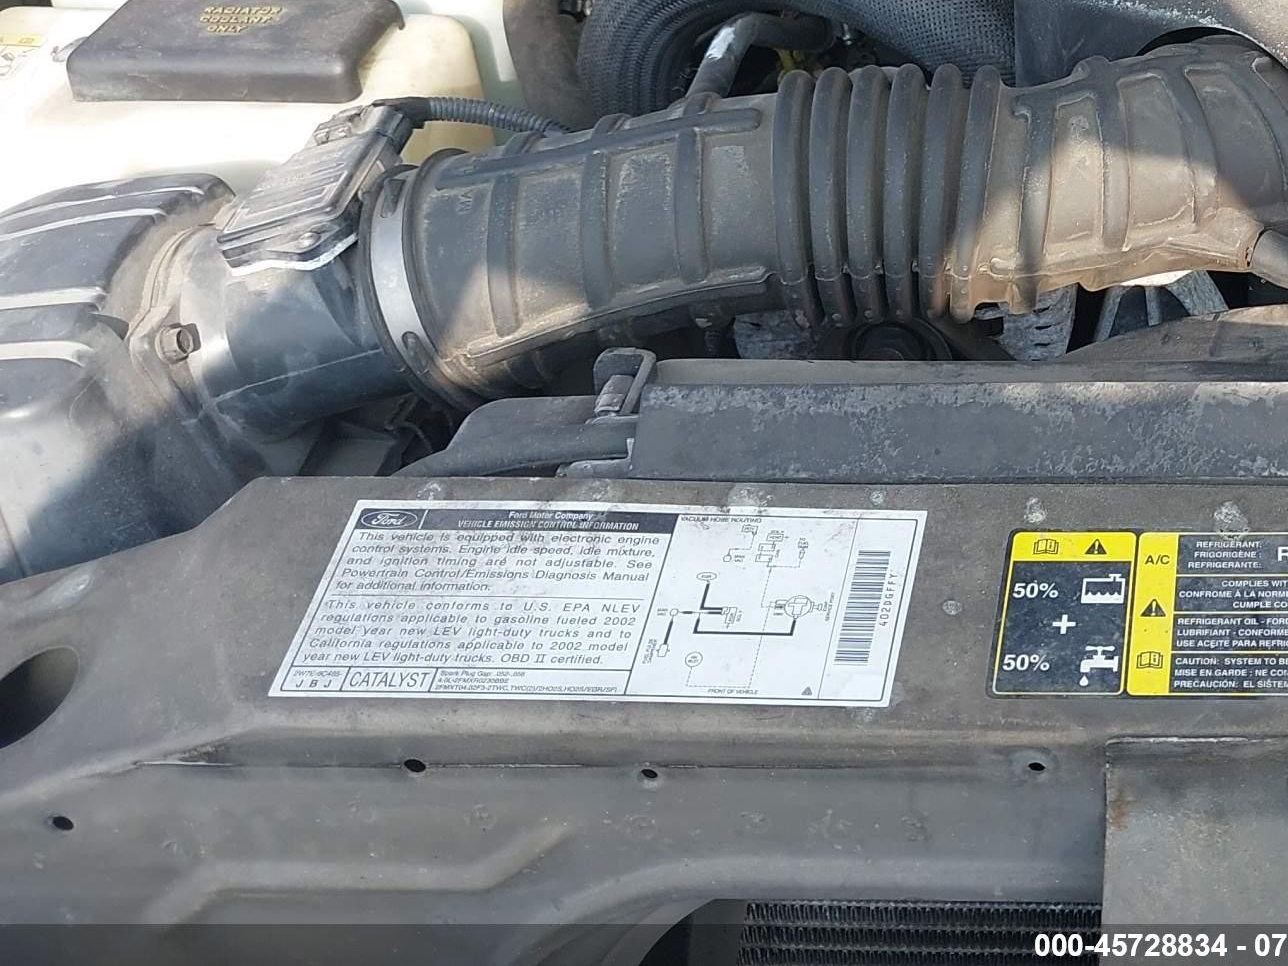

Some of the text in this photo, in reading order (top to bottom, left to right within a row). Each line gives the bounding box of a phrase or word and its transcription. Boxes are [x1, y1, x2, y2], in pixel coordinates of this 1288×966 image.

[203, 6, 283, 15] RADIATOR
[199, 15, 273, 24] COOLANT
[206, 24, 249, 33] ONLY
[371, 512, 408, 527] Ford
[508, 510, 594, 522] Ford Motor Company
[458, 520, 640, 531] VEHICLE EMISSION CONTROL INFORMATION
[360, 532, 660, 547] This vehicle is equipped with electronic engine
[352, 544, 394, 554] control
[399, 545, 452, 556] systems.
[458, 545, 500, 556] Engine
[506, 546, 528, 555] idle
[580, 546, 601, 556] idle
[346, 556, 654, 569] and ignition timing are not adjustable. See
[1144, 554, 1171, 566] A/C
[1188, 562, 1262, 570] REFRIGERANTE:
[341, 568, 650, 582] Powertrain Control/Emissions Diagnosis Manual
[335, 580, 492, 592] for additional information.
[1221, 580, 1270, 588] COMPLIES
[1012, 582, 1059, 599] 50%
[1178, 590, 1233, 599] CONFROME
[327, 600, 642, 614] This vehicle conforms to U.S. EPA NLEV
[1232, 601, 1270, 609] CUMPLE
[320, 614, 636, 626] regulations applicable to gasoline fueled 2002
[1178, 618, 1242, 626] REFRIGERANT
[1244, 618, 1259, 626] OIL
[314, 626, 632, 639] model year new LEV light-duty trucks and to
[1176, 628, 1231, 636] LUBRIFIANT
[310, 638, 629, 652] California regulations applicable to 2002 model
[1176, 640, 1196, 648] USE
[1196, 640, 1230, 648] ACEITE
[1232, 640, 1257, 648] PARA
[302, 652, 604, 665] year new LEV light-duty trucks. OBD II certified.
[1002, 654, 1050, 671] 50%
[1175, 658, 1220, 666] CAUTION:
[1224, 658, 1262, 666] SYSTEM
[1174, 669, 1198, 677] MISE
[1214, 669, 1248, 677] GARDE
[350, 672, 432, 688] CATALYST
[1174, 678, 1239, 688] PRECAUCIÓN:
